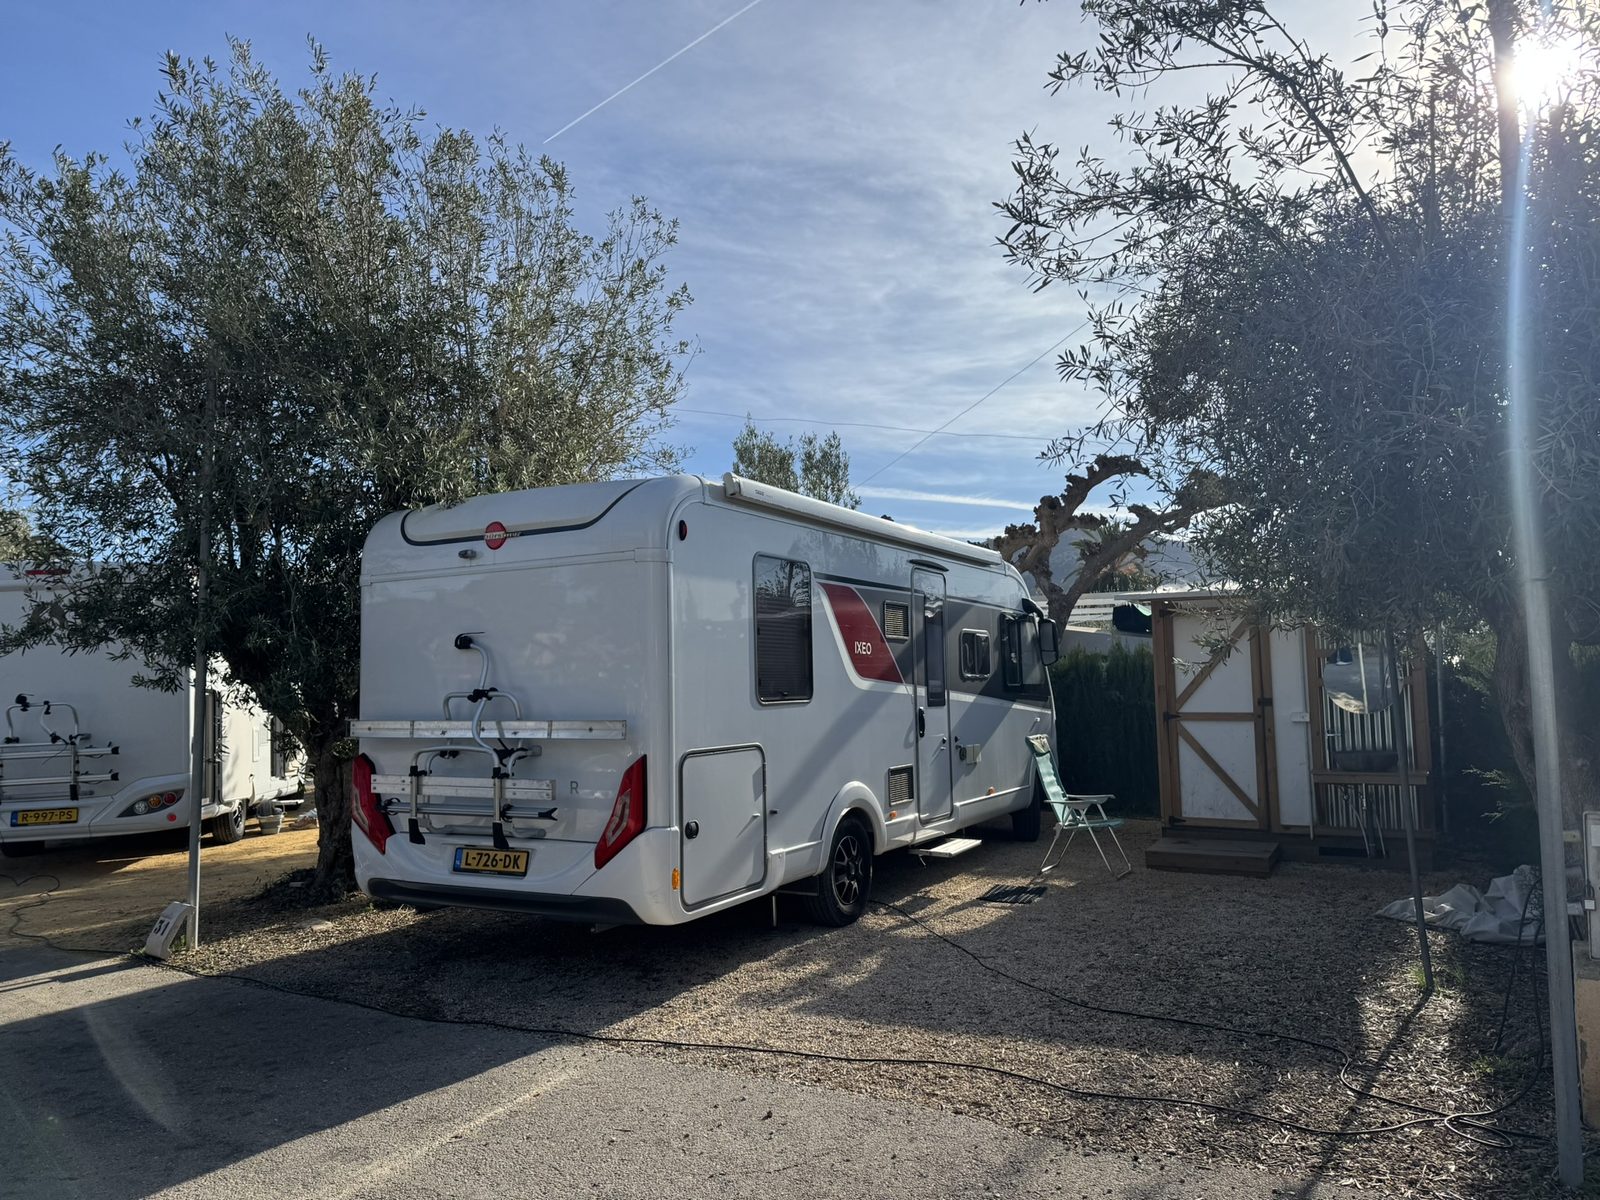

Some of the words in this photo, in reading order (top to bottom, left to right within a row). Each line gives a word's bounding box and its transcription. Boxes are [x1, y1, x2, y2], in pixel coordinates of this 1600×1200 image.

[854, 641, 872, 655] IXEO
[21, 810, 73, 823] R-997-PS
[464, 851, 521, 870] L-726-DK
